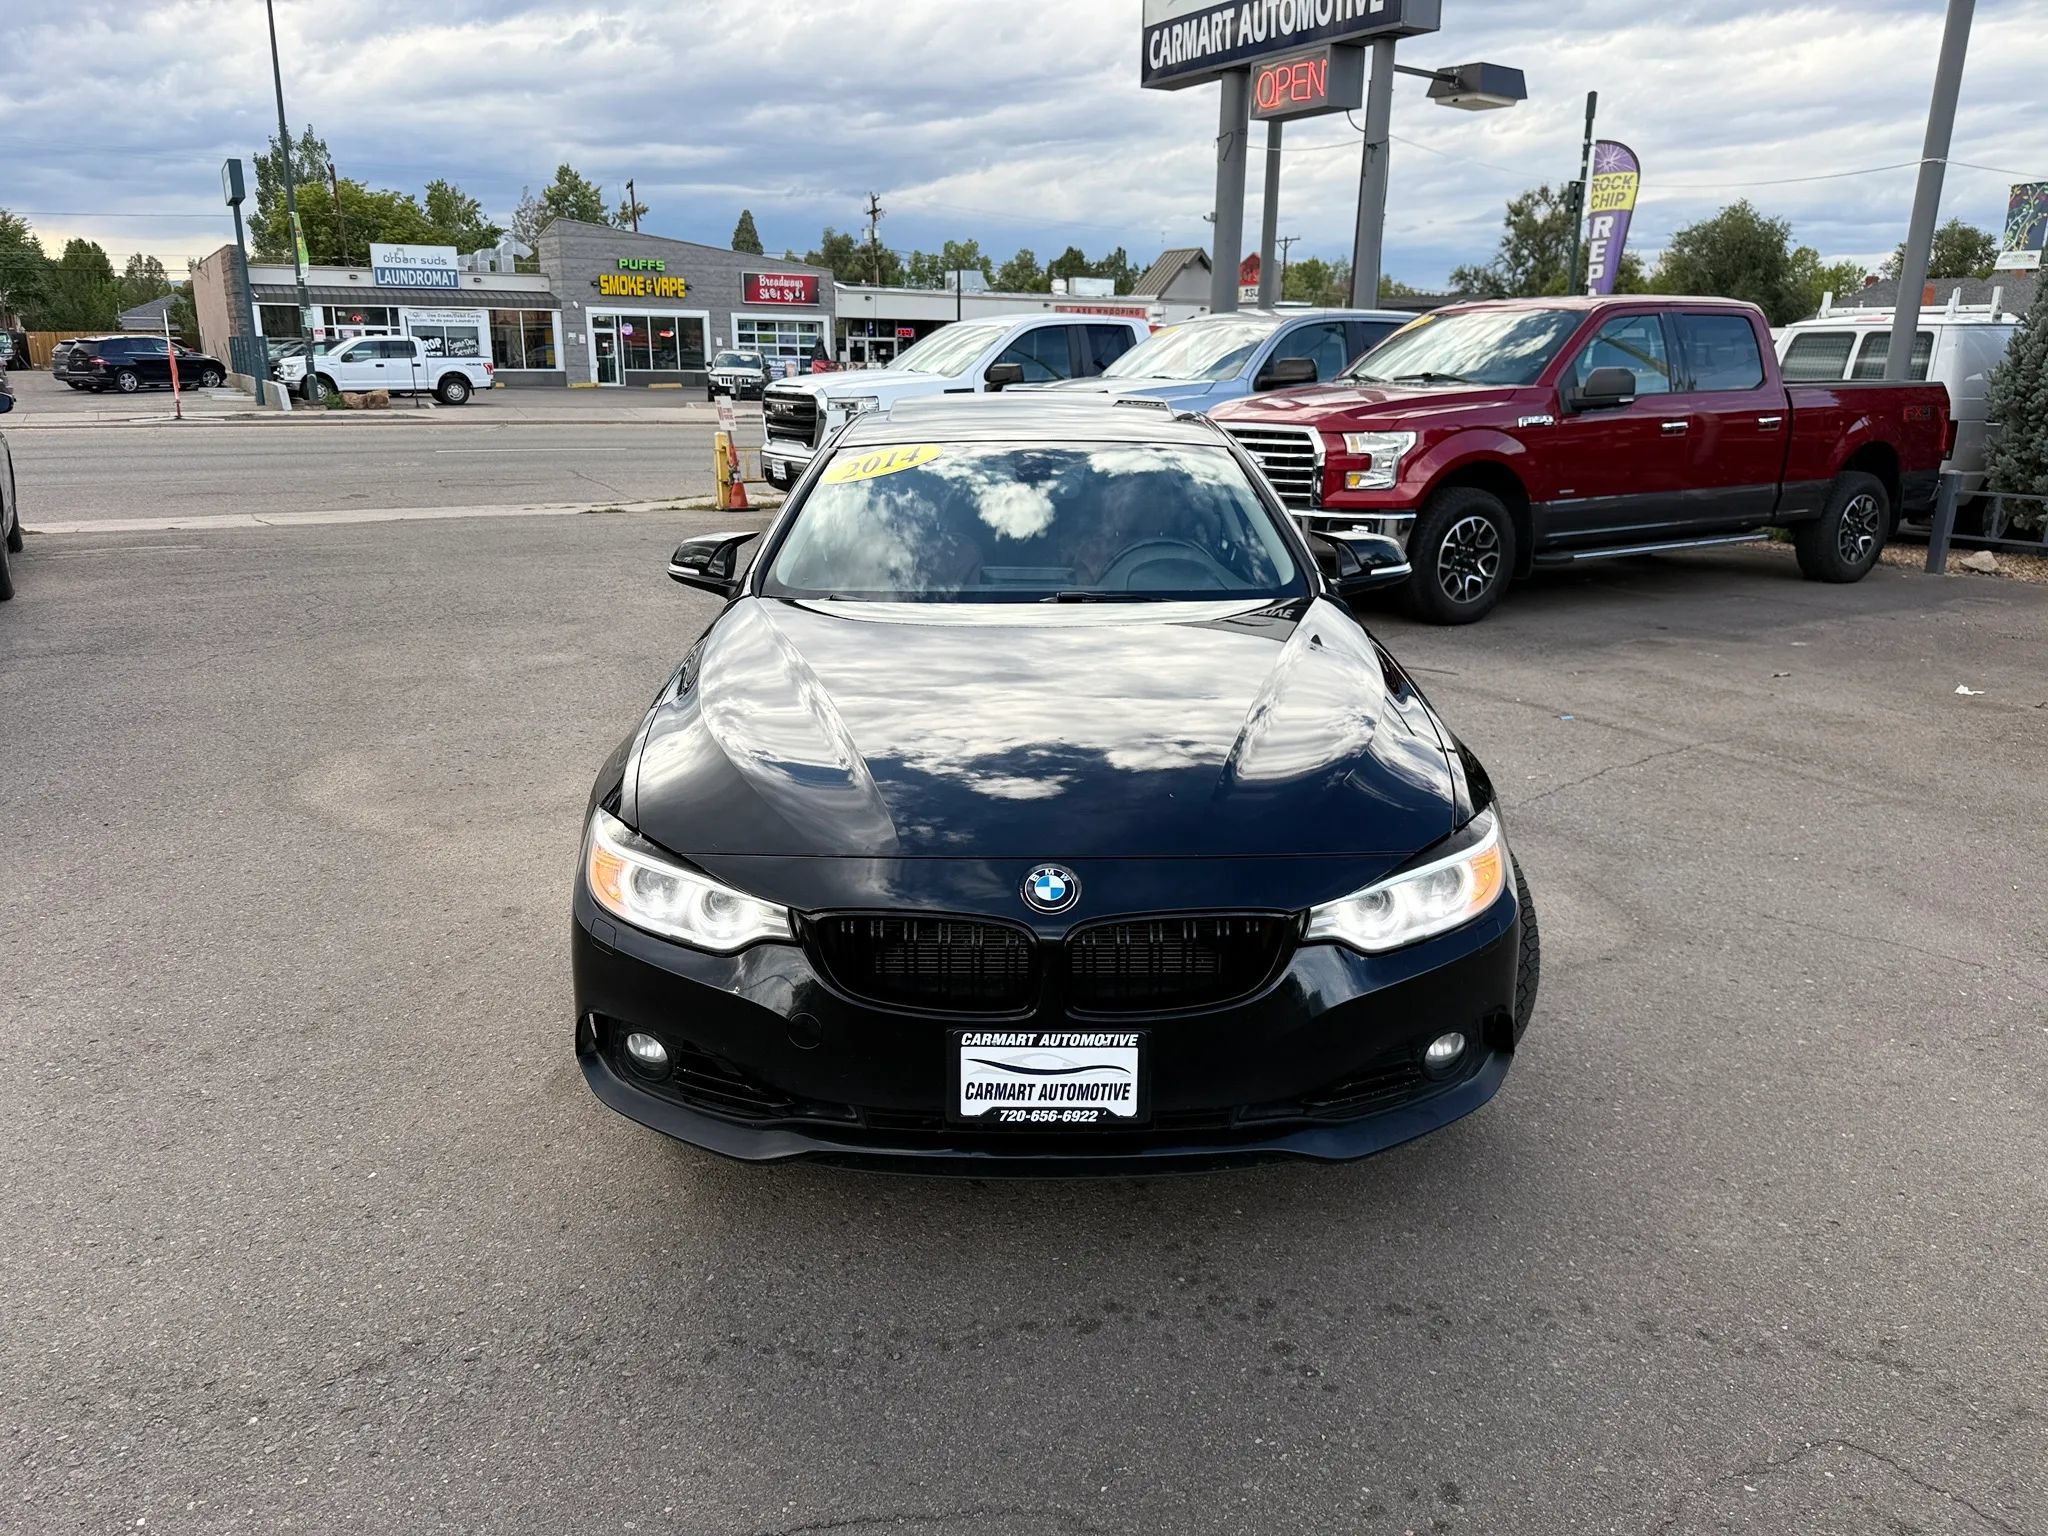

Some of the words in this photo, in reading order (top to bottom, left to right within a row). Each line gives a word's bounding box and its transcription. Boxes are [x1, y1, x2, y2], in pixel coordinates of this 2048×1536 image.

[1149, 10, 1235, 70] CARMART
[1256, 58, 1328, 109] OPEN
[1591, 175, 1635, 193] ROCK
[1590, 192, 1626, 209] CHIP
[383, 252, 417, 264] urban
[420, 256, 447, 265] suds
[618, 258, 666, 271] PUFFS
[376, 269, 456, 287] LAUNDROMAT
[599, 274, 645, 296] SMOKE
[645, 279, 653, 293] &
[652, 276, 686, 298] VAPE
[423, 337, 442, 351] ROP
[842, 447, 921, 479] 2014
[1029, 869, 1071, 882] BMW
[961, 1033, 1037, 1047] CARMART
[1039, 1034, 1139, 1047] AUTOMOTIVE
[965, 1082, 1036, 1101] CARMART
[1038, 1083, 1132, 1101] AUTOMOTIVE
[999, 1109, 1099, 1123] 720-656-6922
